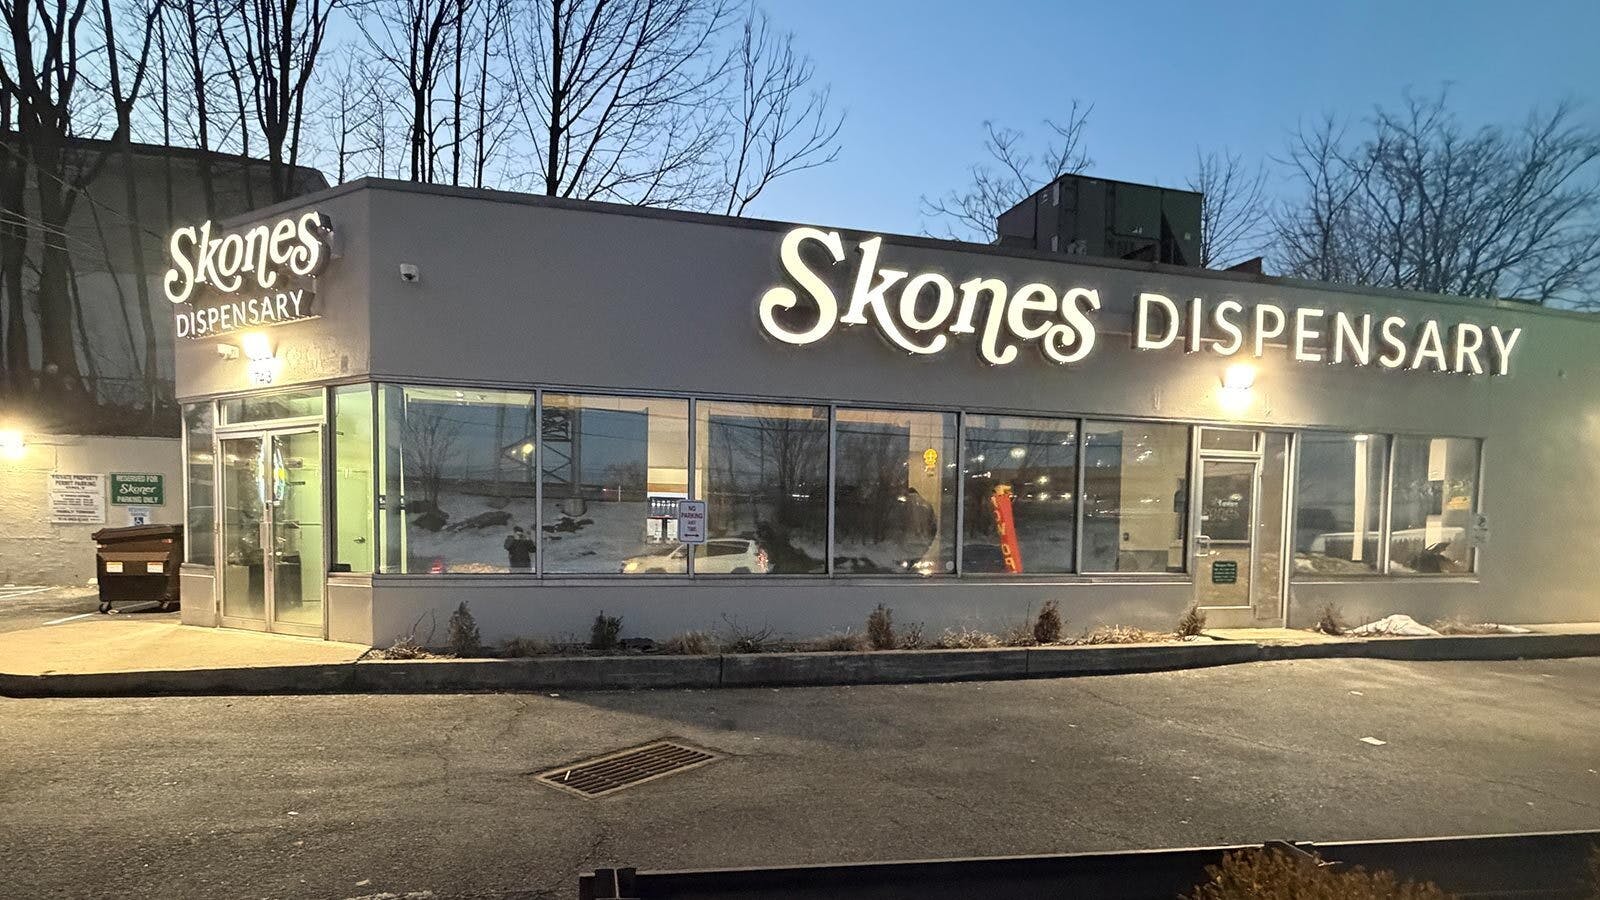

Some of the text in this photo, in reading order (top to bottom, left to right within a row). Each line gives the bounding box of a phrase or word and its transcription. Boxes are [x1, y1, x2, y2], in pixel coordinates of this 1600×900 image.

[164, 211, 323, 303] Skones
[758, 227, 1522, 376] Skones DISPENSARY
[176, 289, 304, 338] DISPENSARY
